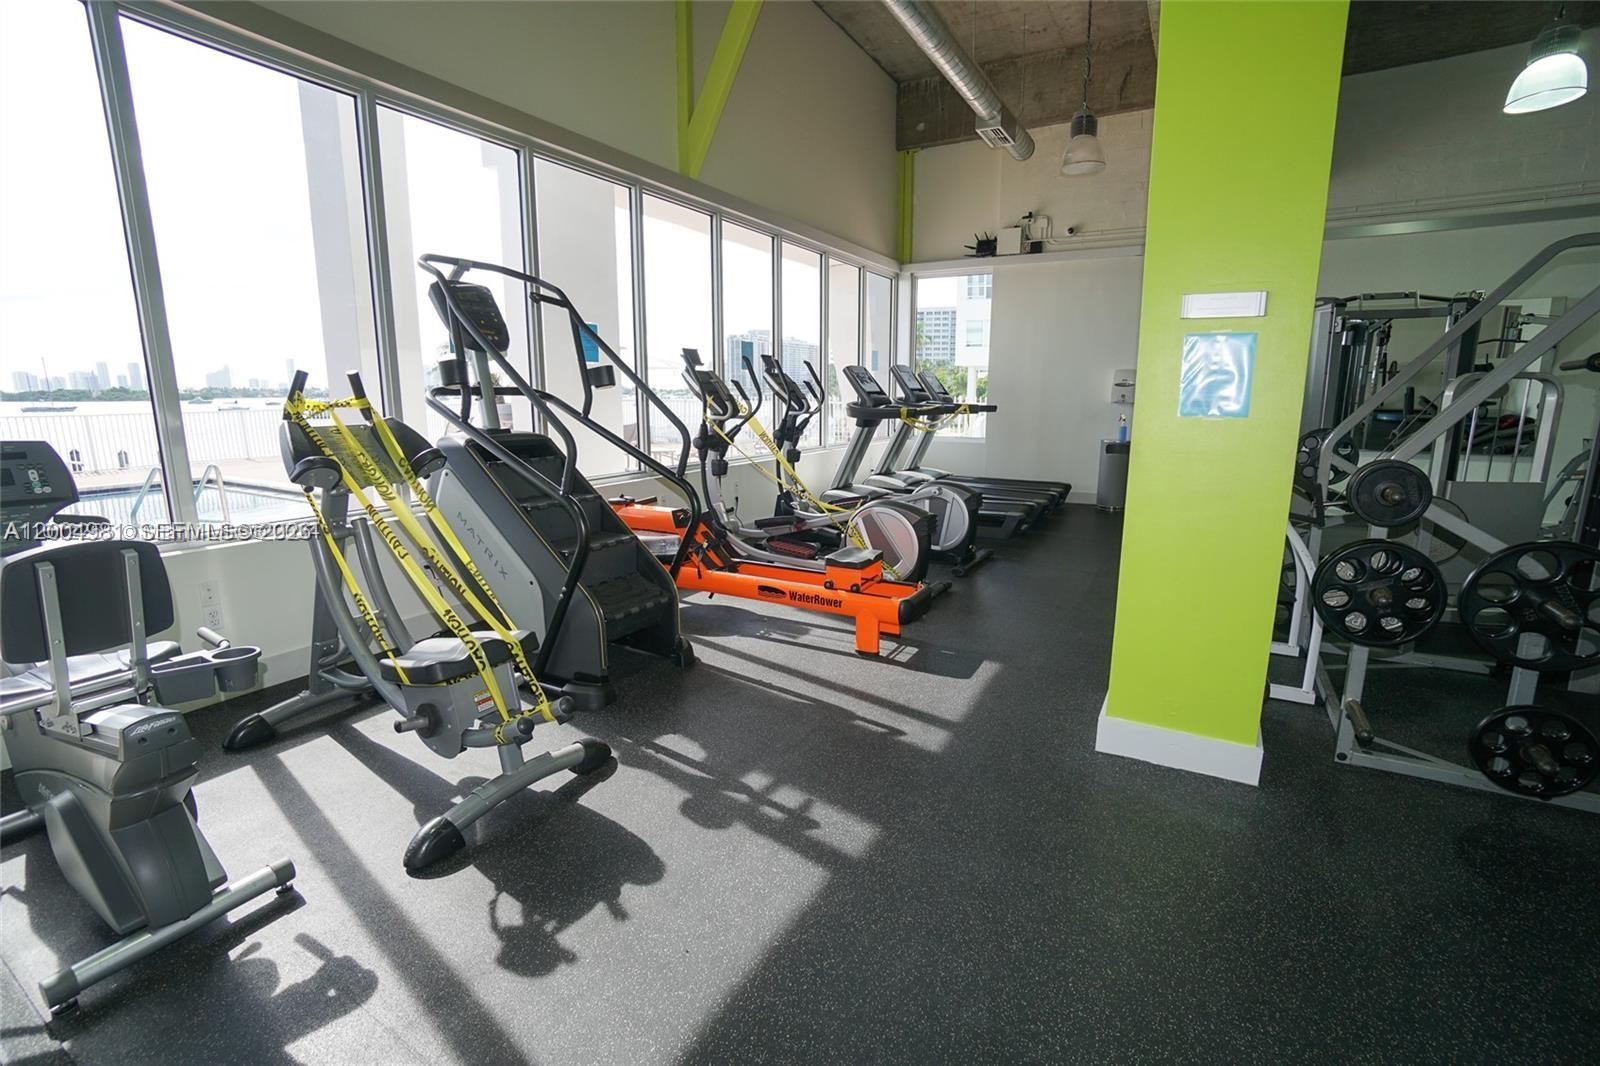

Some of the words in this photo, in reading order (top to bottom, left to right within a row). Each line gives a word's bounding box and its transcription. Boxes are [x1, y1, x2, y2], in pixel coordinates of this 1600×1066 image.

[456, 511, 509, 580] MATRIX
[788, 590, 843, 609] WaterRower
[443, 607, 487, 672] CAUTION
